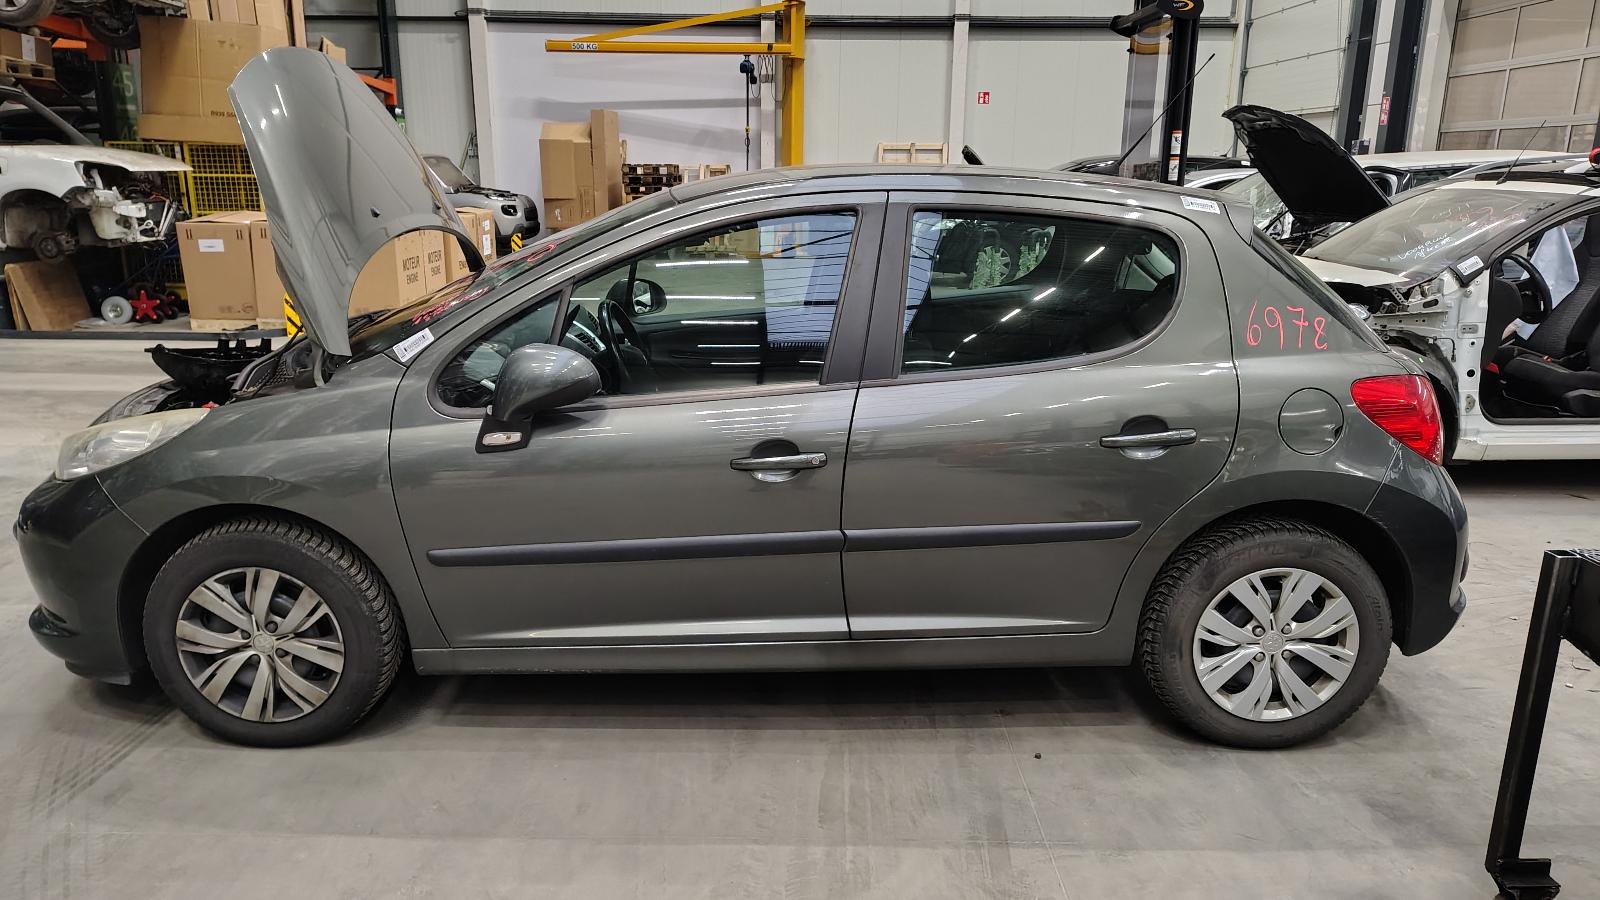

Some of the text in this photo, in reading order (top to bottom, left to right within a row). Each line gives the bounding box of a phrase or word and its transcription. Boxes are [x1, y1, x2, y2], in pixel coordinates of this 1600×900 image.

[402, 255, 420, 272] MOTEUR
[427, 249, 442, 265] MOTEUR
[406, 271, 419, 285] ENGINE
[430, 264, 442, 277] ENGINE
[1247, 300, 1328, 350] 6978
